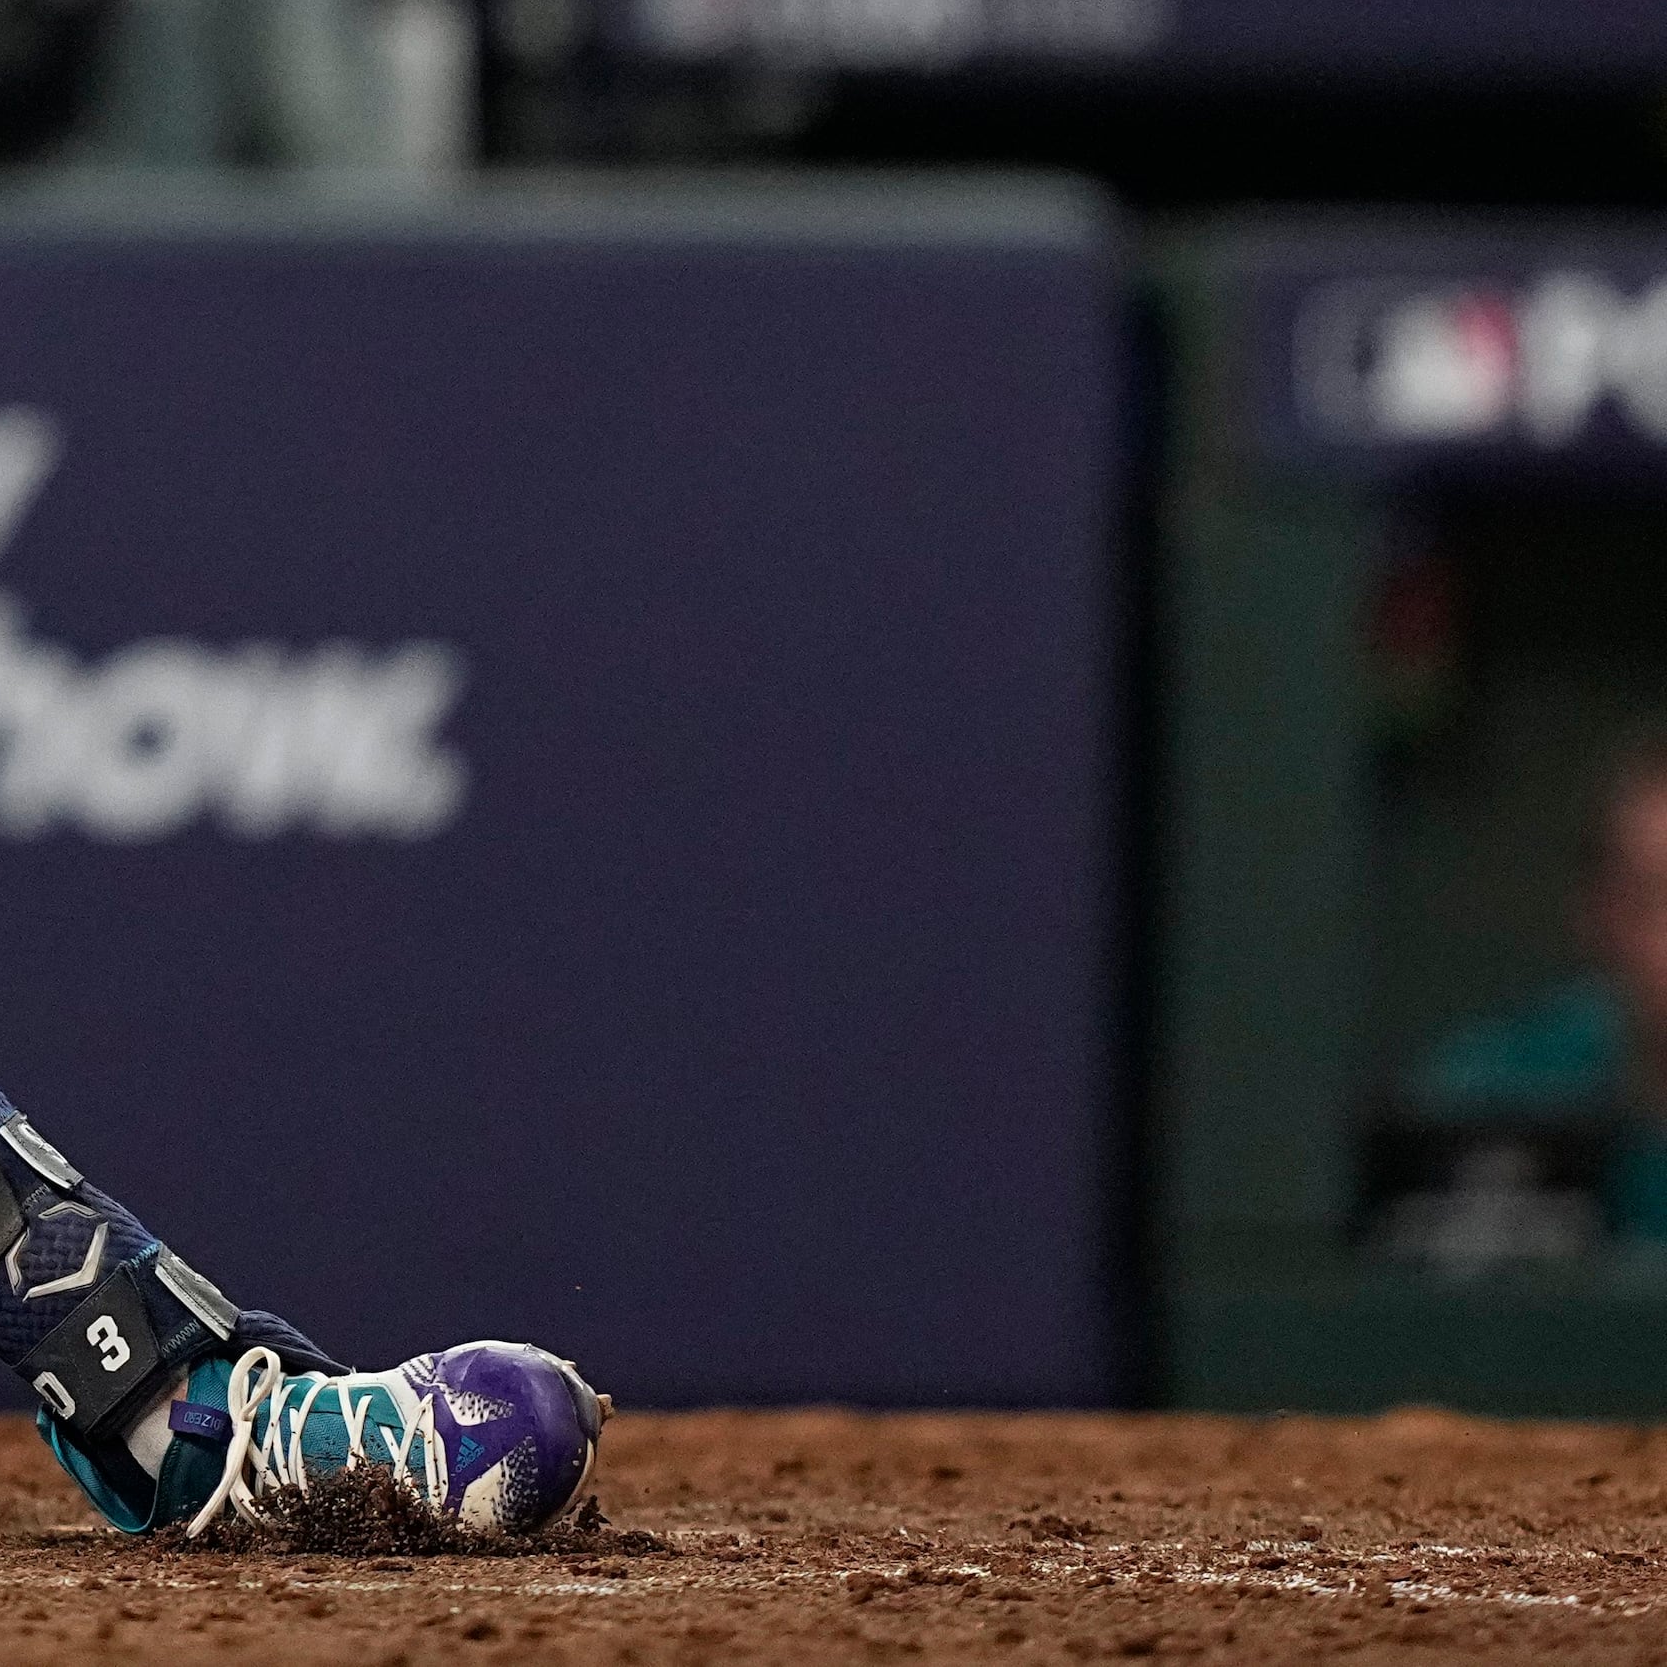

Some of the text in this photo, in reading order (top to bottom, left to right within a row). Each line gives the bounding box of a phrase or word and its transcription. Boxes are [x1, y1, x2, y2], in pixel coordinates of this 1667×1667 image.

[86, 1314, 131, 1373] 3
[183, 1411, 225, 1431] DIZERO
[455, 1445, 485, 1473] adidas
